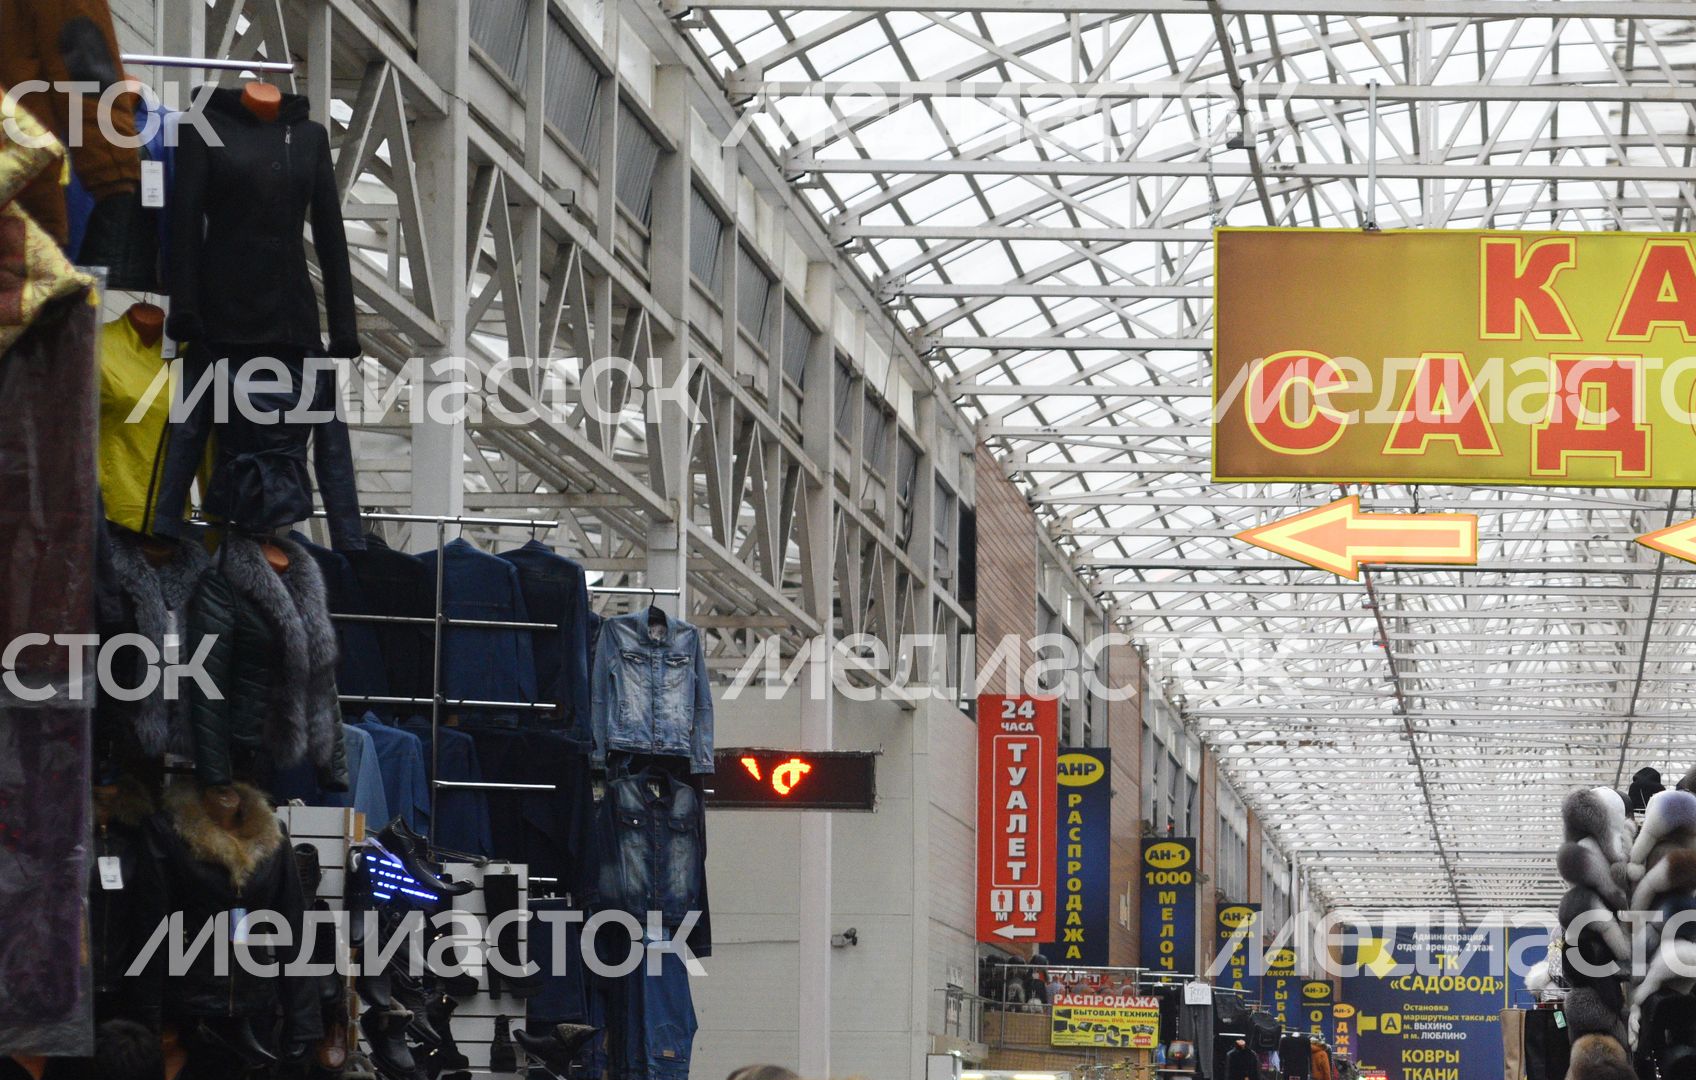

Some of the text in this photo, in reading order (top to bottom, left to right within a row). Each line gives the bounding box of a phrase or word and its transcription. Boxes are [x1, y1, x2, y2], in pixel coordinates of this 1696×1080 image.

[1001, 700, 1036, 719] 24
[1001, 721, 1035, 732] ЧАСА
[1006, 742, 1029, 881] ТУАЛЕТ
[1148, 850, 1186, 861] АН-1
[1063, 793, 1085, 960] РАСПРОДАЖА
[1145, 872, 1192, 885] 1000
[995, 911, 1037, 921] М Ж
[1435, 954, 1460, 970] ТК
[1390, 976, 1504, 994] «САДОВОД»
[1053, 993, 1160, 1009] РАСПРОДАЖА
[1073, 1009, 1159, 1018] БЫТОВАЯ ТЕХНИКА
[1403, 1004, 1449, 1012] Остановка
[1403, 1014, 1459, 1022] маршрутных
[1461, 1014, 1485, 1022] такси
[1421, 1032, 1467, 1040] ЛЮБЛИНО
[1402, 1049, 1460, 1063] КОВРЫ
[1402, 1068, 1459, 1080] ТКАНИ
